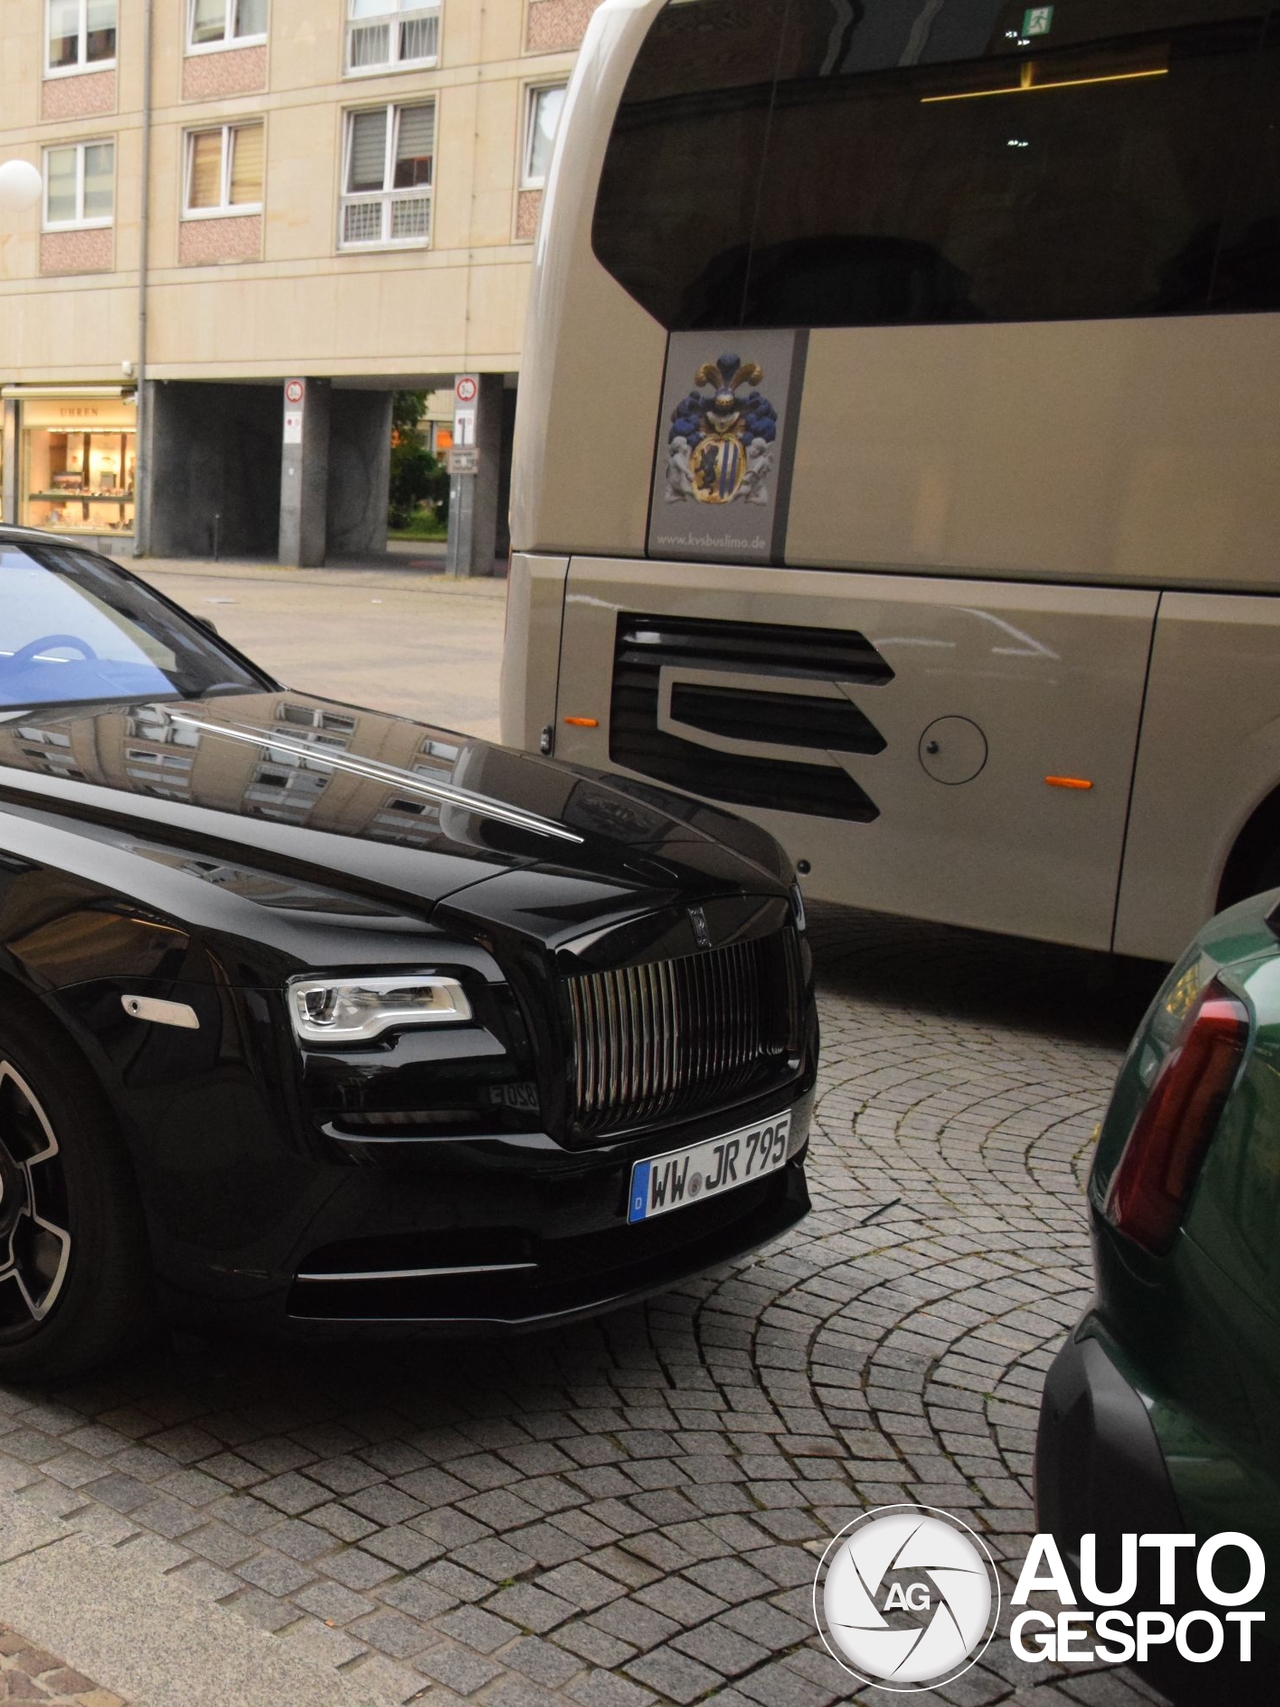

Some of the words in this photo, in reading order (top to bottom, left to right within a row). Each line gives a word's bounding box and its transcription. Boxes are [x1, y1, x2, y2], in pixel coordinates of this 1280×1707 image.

[60, 408, 99, 418] UHREN
[657, 533, 765, 549] www.kvsbuslimo.de
[651, 1156, 689, 1209] WW
[705, 1139, 740, 1191] JR
[745, 1120, 788, 1176] 795
[635, 1197, 642, 1210] D
